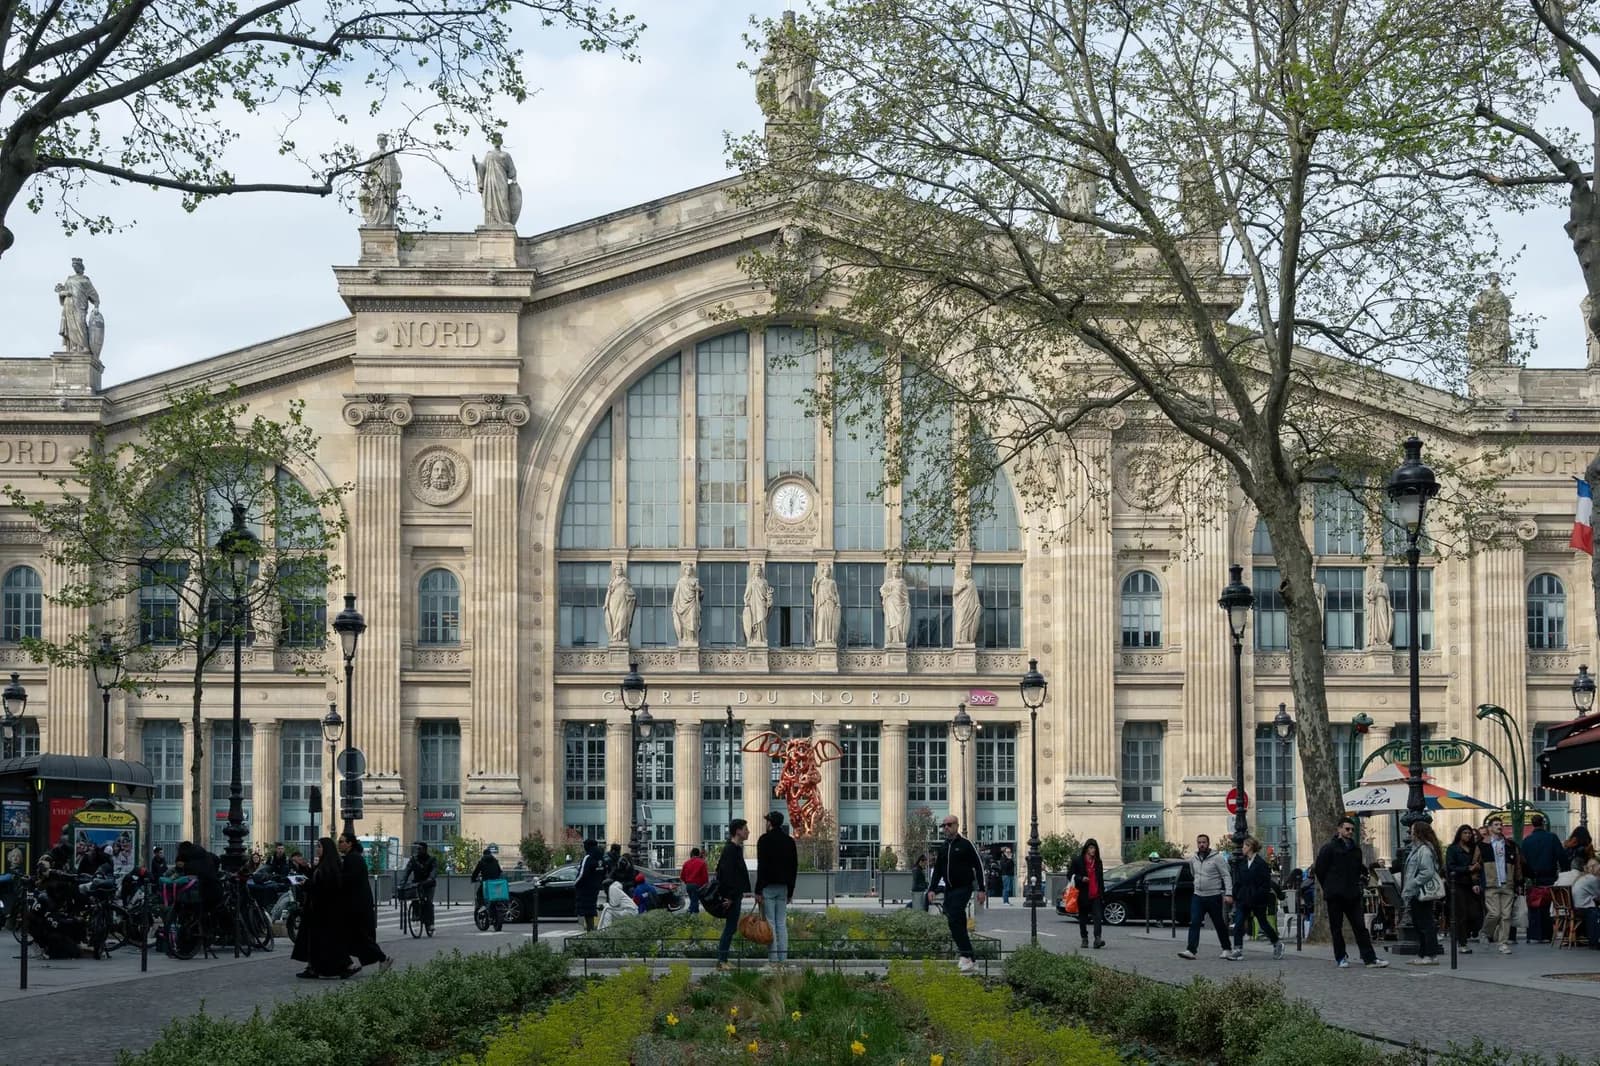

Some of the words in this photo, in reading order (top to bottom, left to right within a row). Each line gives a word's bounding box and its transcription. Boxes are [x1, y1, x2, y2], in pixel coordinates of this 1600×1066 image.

[392, 321, 482, 348] NORD
[602, 691, 701, 704] GRE
[737, 691, 778, 705] DU
[811, 690, 910, 704] NORD
[971, 695, 996, 703] SNCF
[1345, 798, 1391, 807] GALLIA
